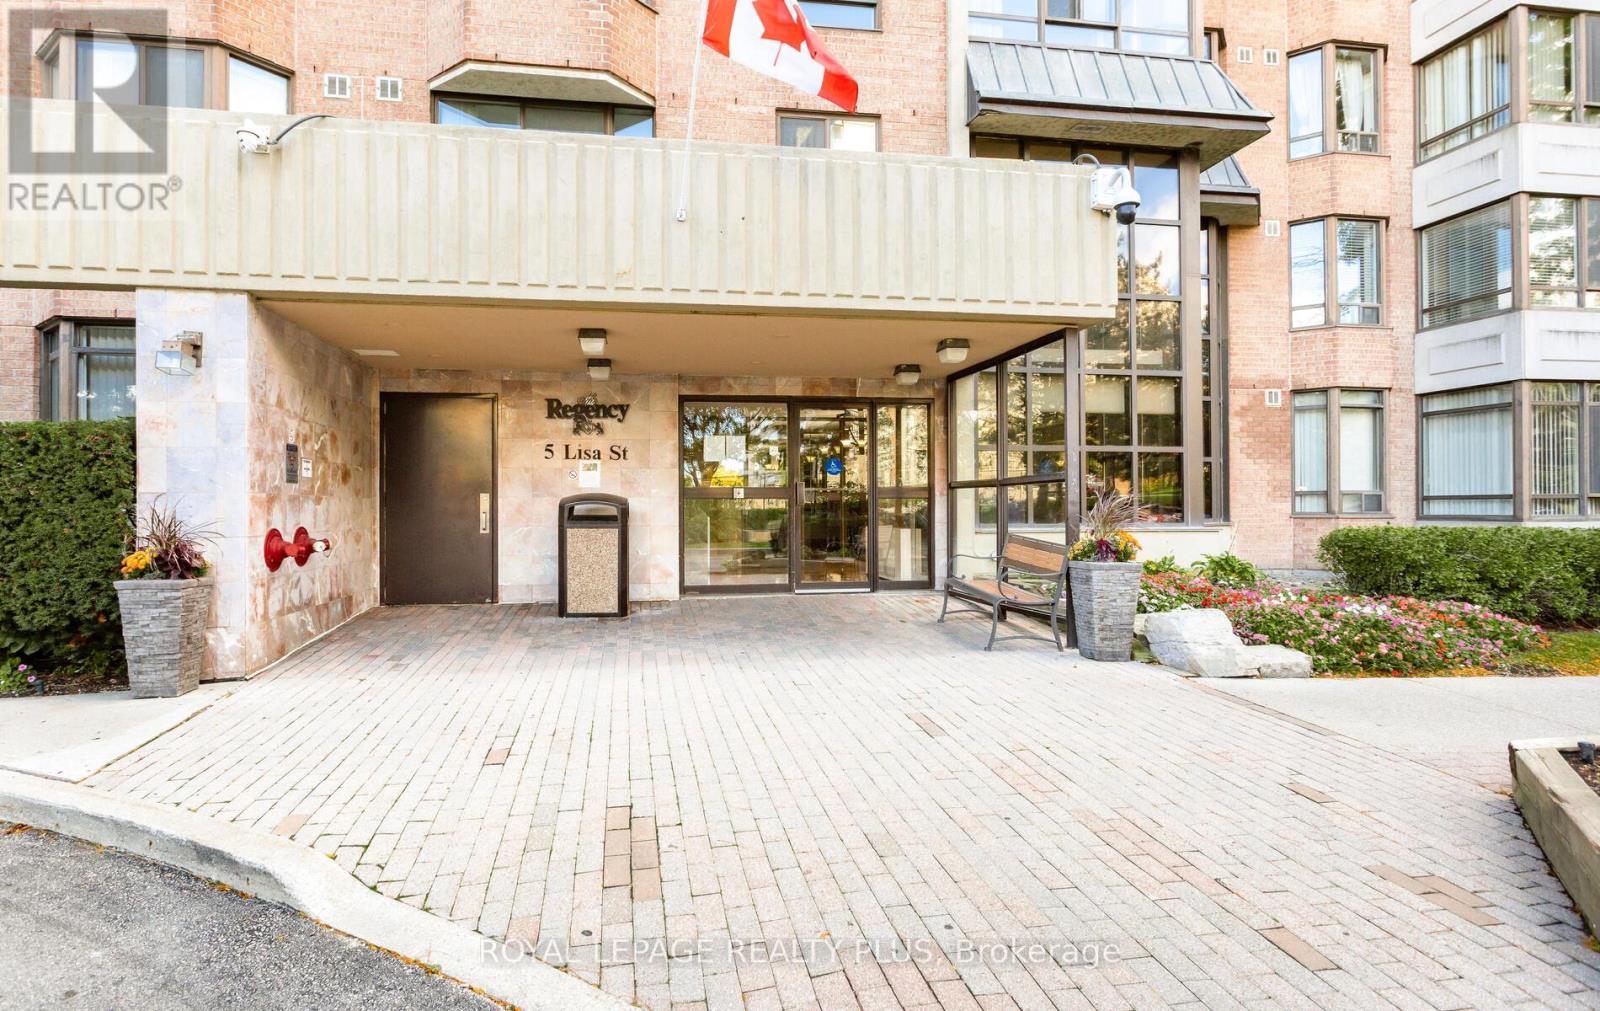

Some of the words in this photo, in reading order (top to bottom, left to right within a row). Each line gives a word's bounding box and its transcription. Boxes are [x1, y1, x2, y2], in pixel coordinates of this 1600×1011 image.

[545, 398, 631, 423] Regency
[544, 443, 554, 460] 5
[564, 443, 601, 460] Lisa
[609, 444, 629, 460] St
